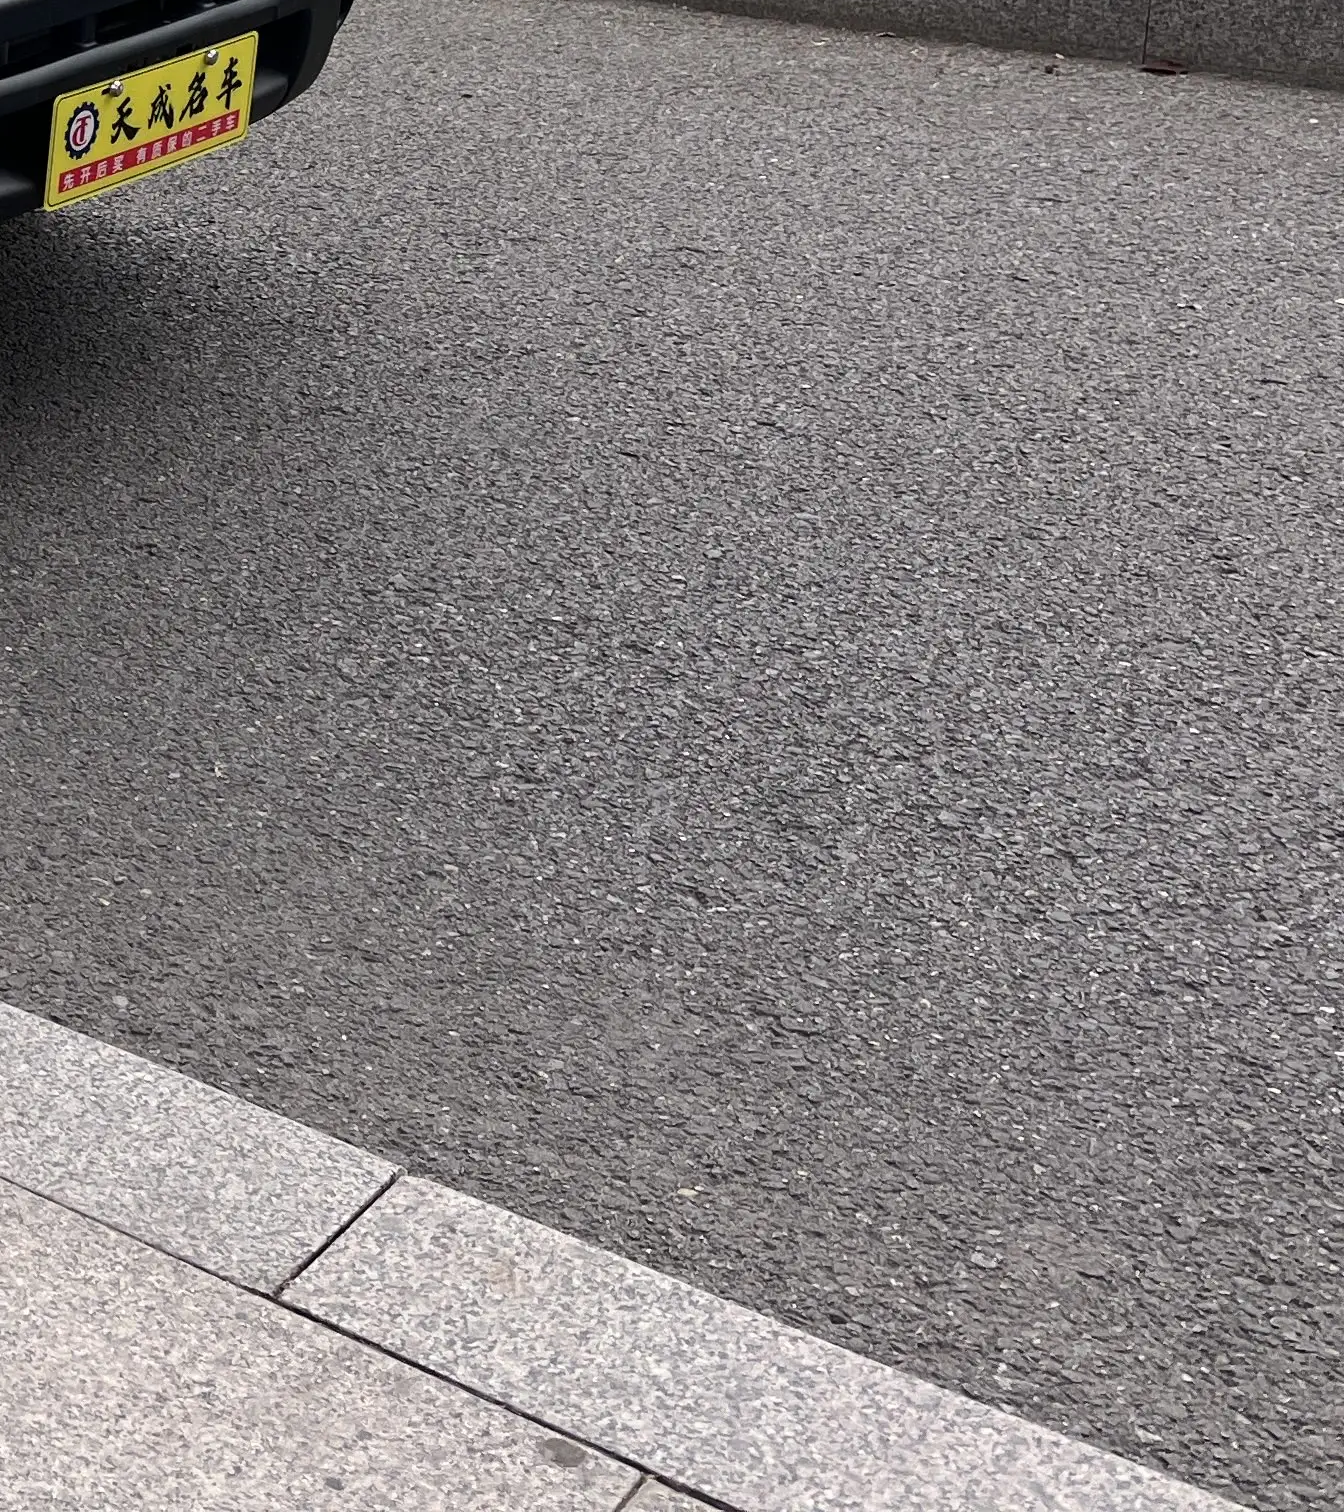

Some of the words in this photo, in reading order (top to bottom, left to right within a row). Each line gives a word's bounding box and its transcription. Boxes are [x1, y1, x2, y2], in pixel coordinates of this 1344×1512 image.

[102, 56, 243, 144] 天成名车
[62, 155, 124, 191] 先开后买
[135, 113, 239, 165] 有质保的二手车
